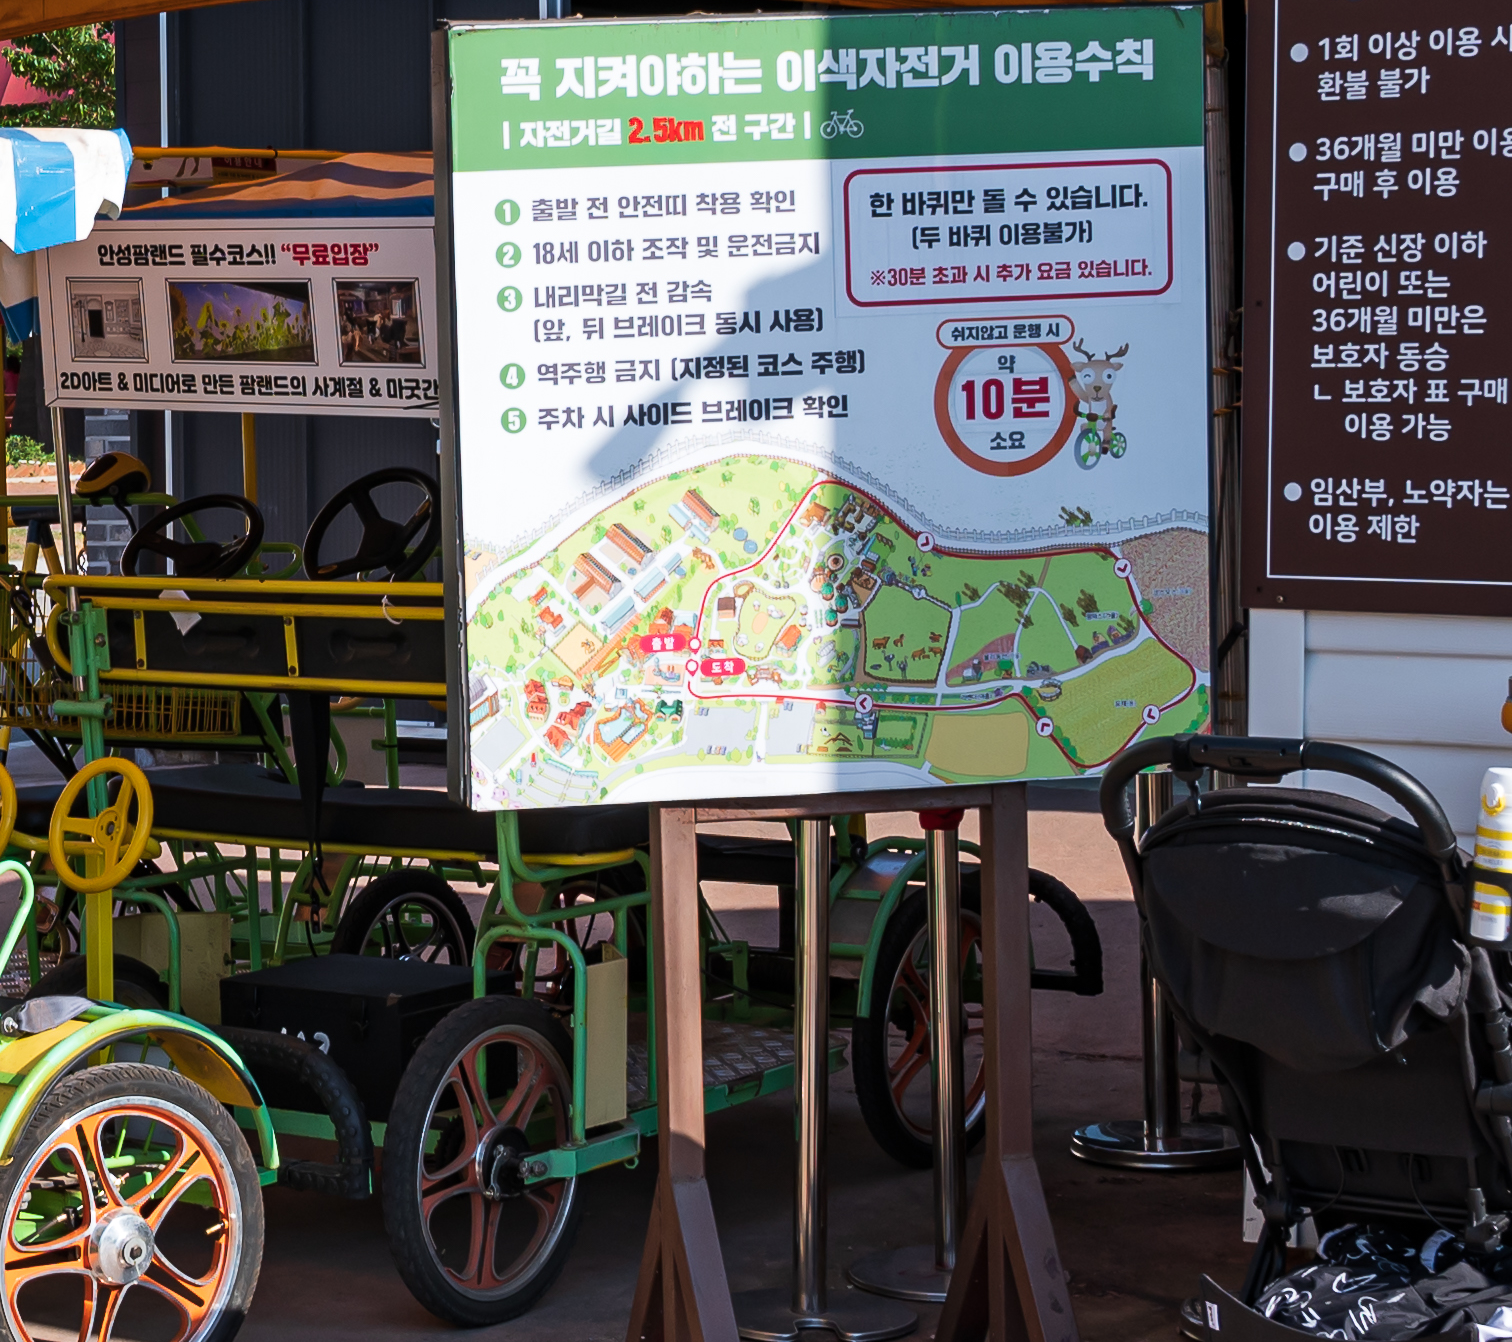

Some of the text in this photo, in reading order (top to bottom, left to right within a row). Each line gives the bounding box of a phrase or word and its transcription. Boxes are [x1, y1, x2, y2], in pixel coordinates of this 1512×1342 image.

[1318, 33, 1358, 61] 1회
[1368, 30, 1420, 60] 이상
[1429, 27, 1481, 57] 이용
[500, 38, 1154, 101] 꼭 지켜야하는 이색자전거 이용수칙
[1317, 66, 1430, 101] 환불 불가
[520, 113, 795, 148] 자전거길 2.5km 전 구간
[531, 189, 796, 222] 출발 전 안전띠 착용 확인
[869, 183, 1148, 218] 한 바퀴만 돌 수 있습니다.
[98, 243, 186, 267] 안성팜랜드
[190, 243, 276, 267] 필수코스!!
[998, 355, 1015, 373] 약
[961, 377, 1050, 421] 10분
[990, 431, 1025, 451] 소요
[651, 636, 675, 651] 출발
[711, 660, 734, 675] 도착
